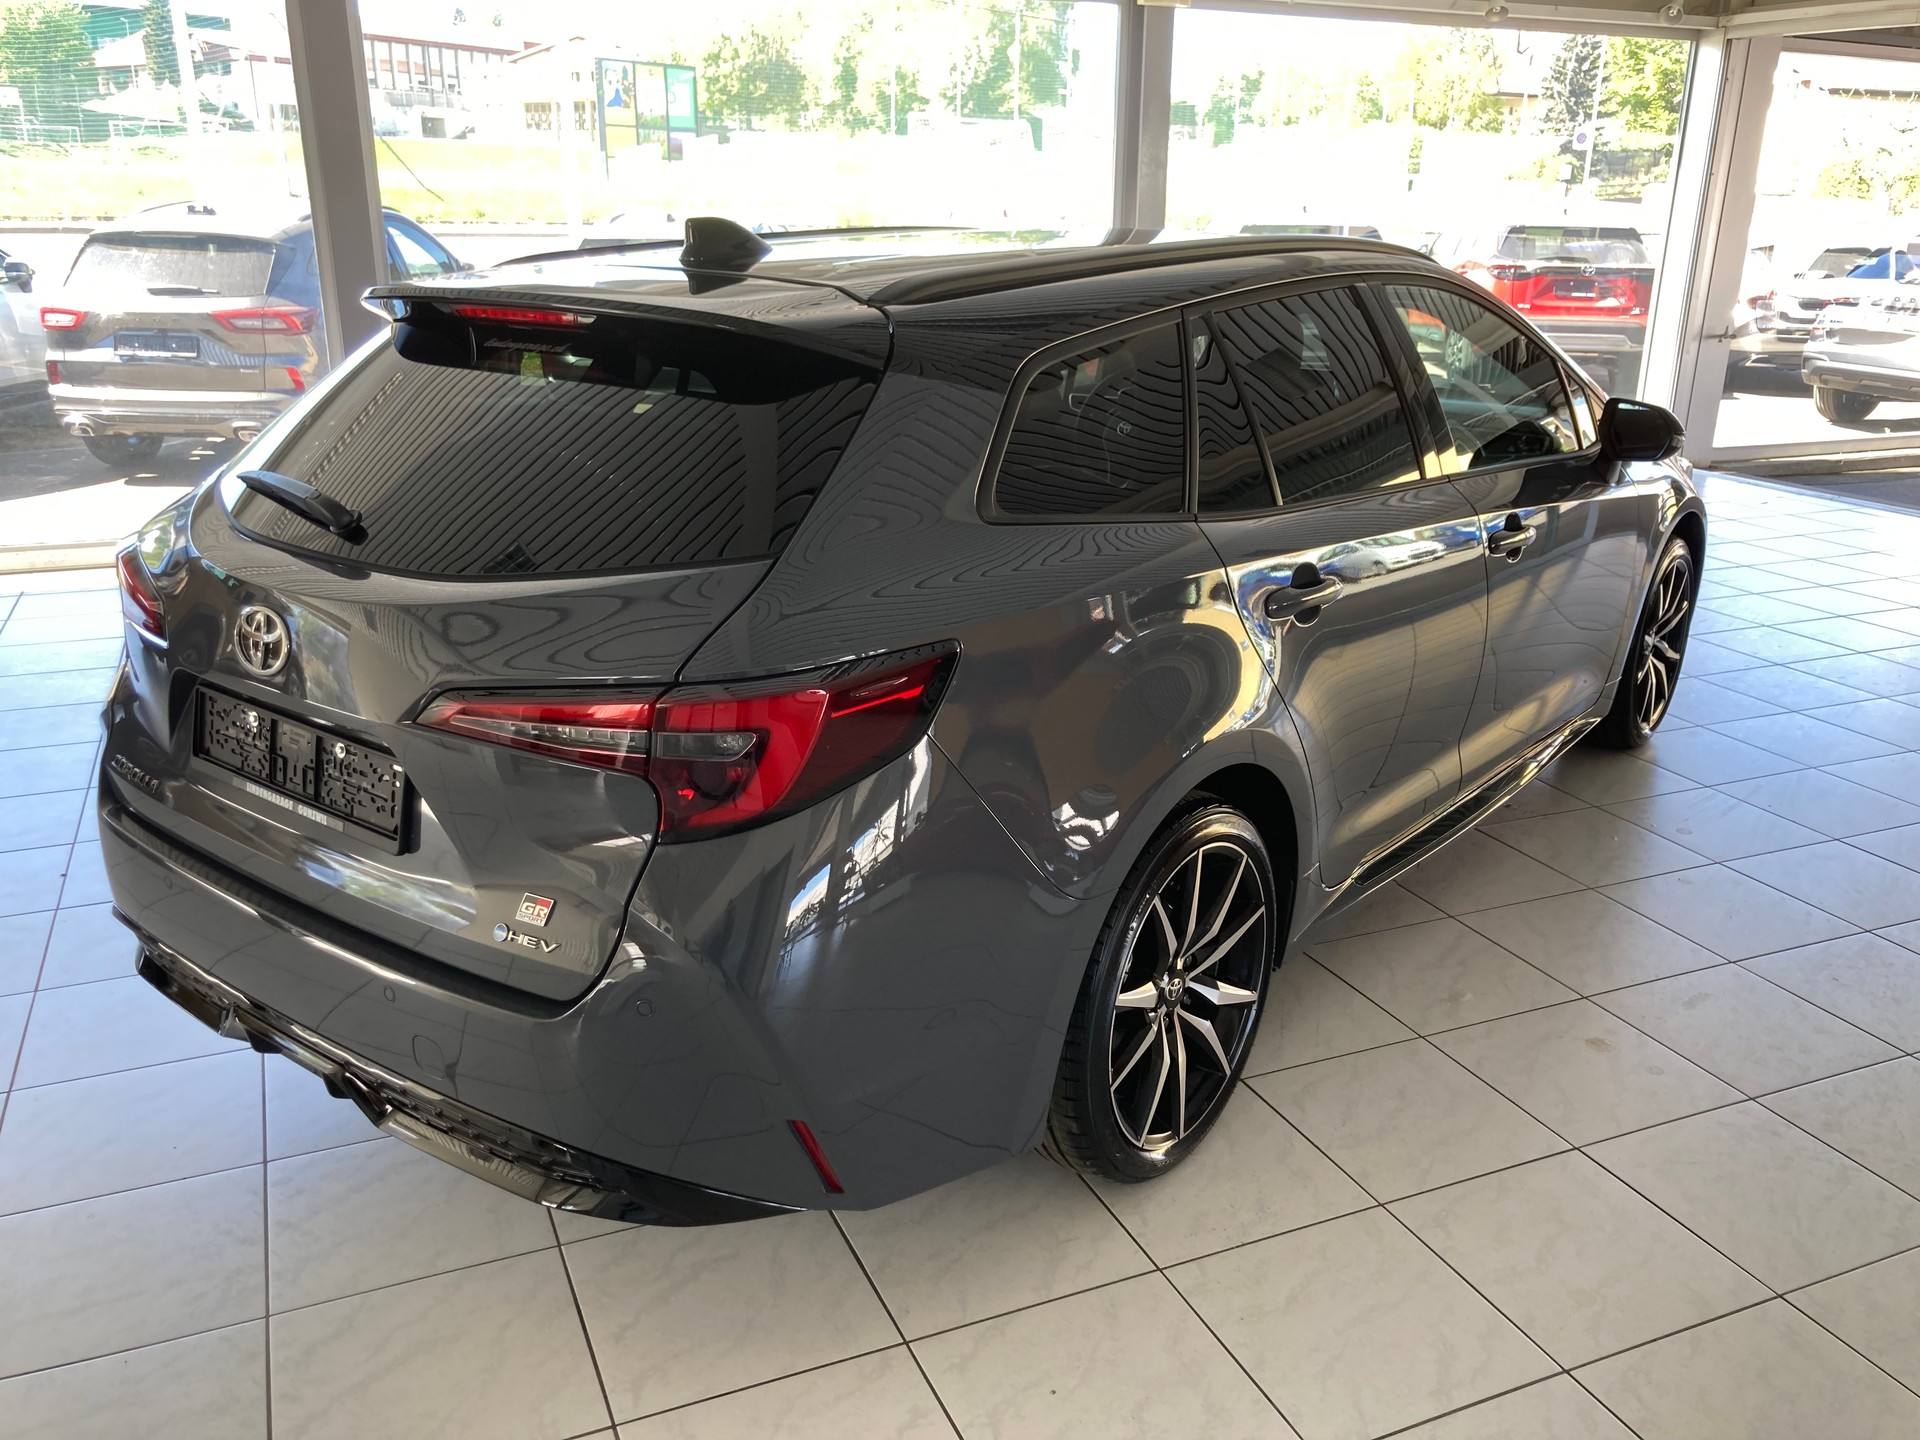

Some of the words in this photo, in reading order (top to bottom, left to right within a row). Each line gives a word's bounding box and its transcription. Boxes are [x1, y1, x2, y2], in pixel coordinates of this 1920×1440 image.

[246, 781, 294, 811] LINDENGARAGE
[517, 912, 545, 925] SPORT
[520, 901, 549, 919] GR
[507, 930, 561, 953] HEV
